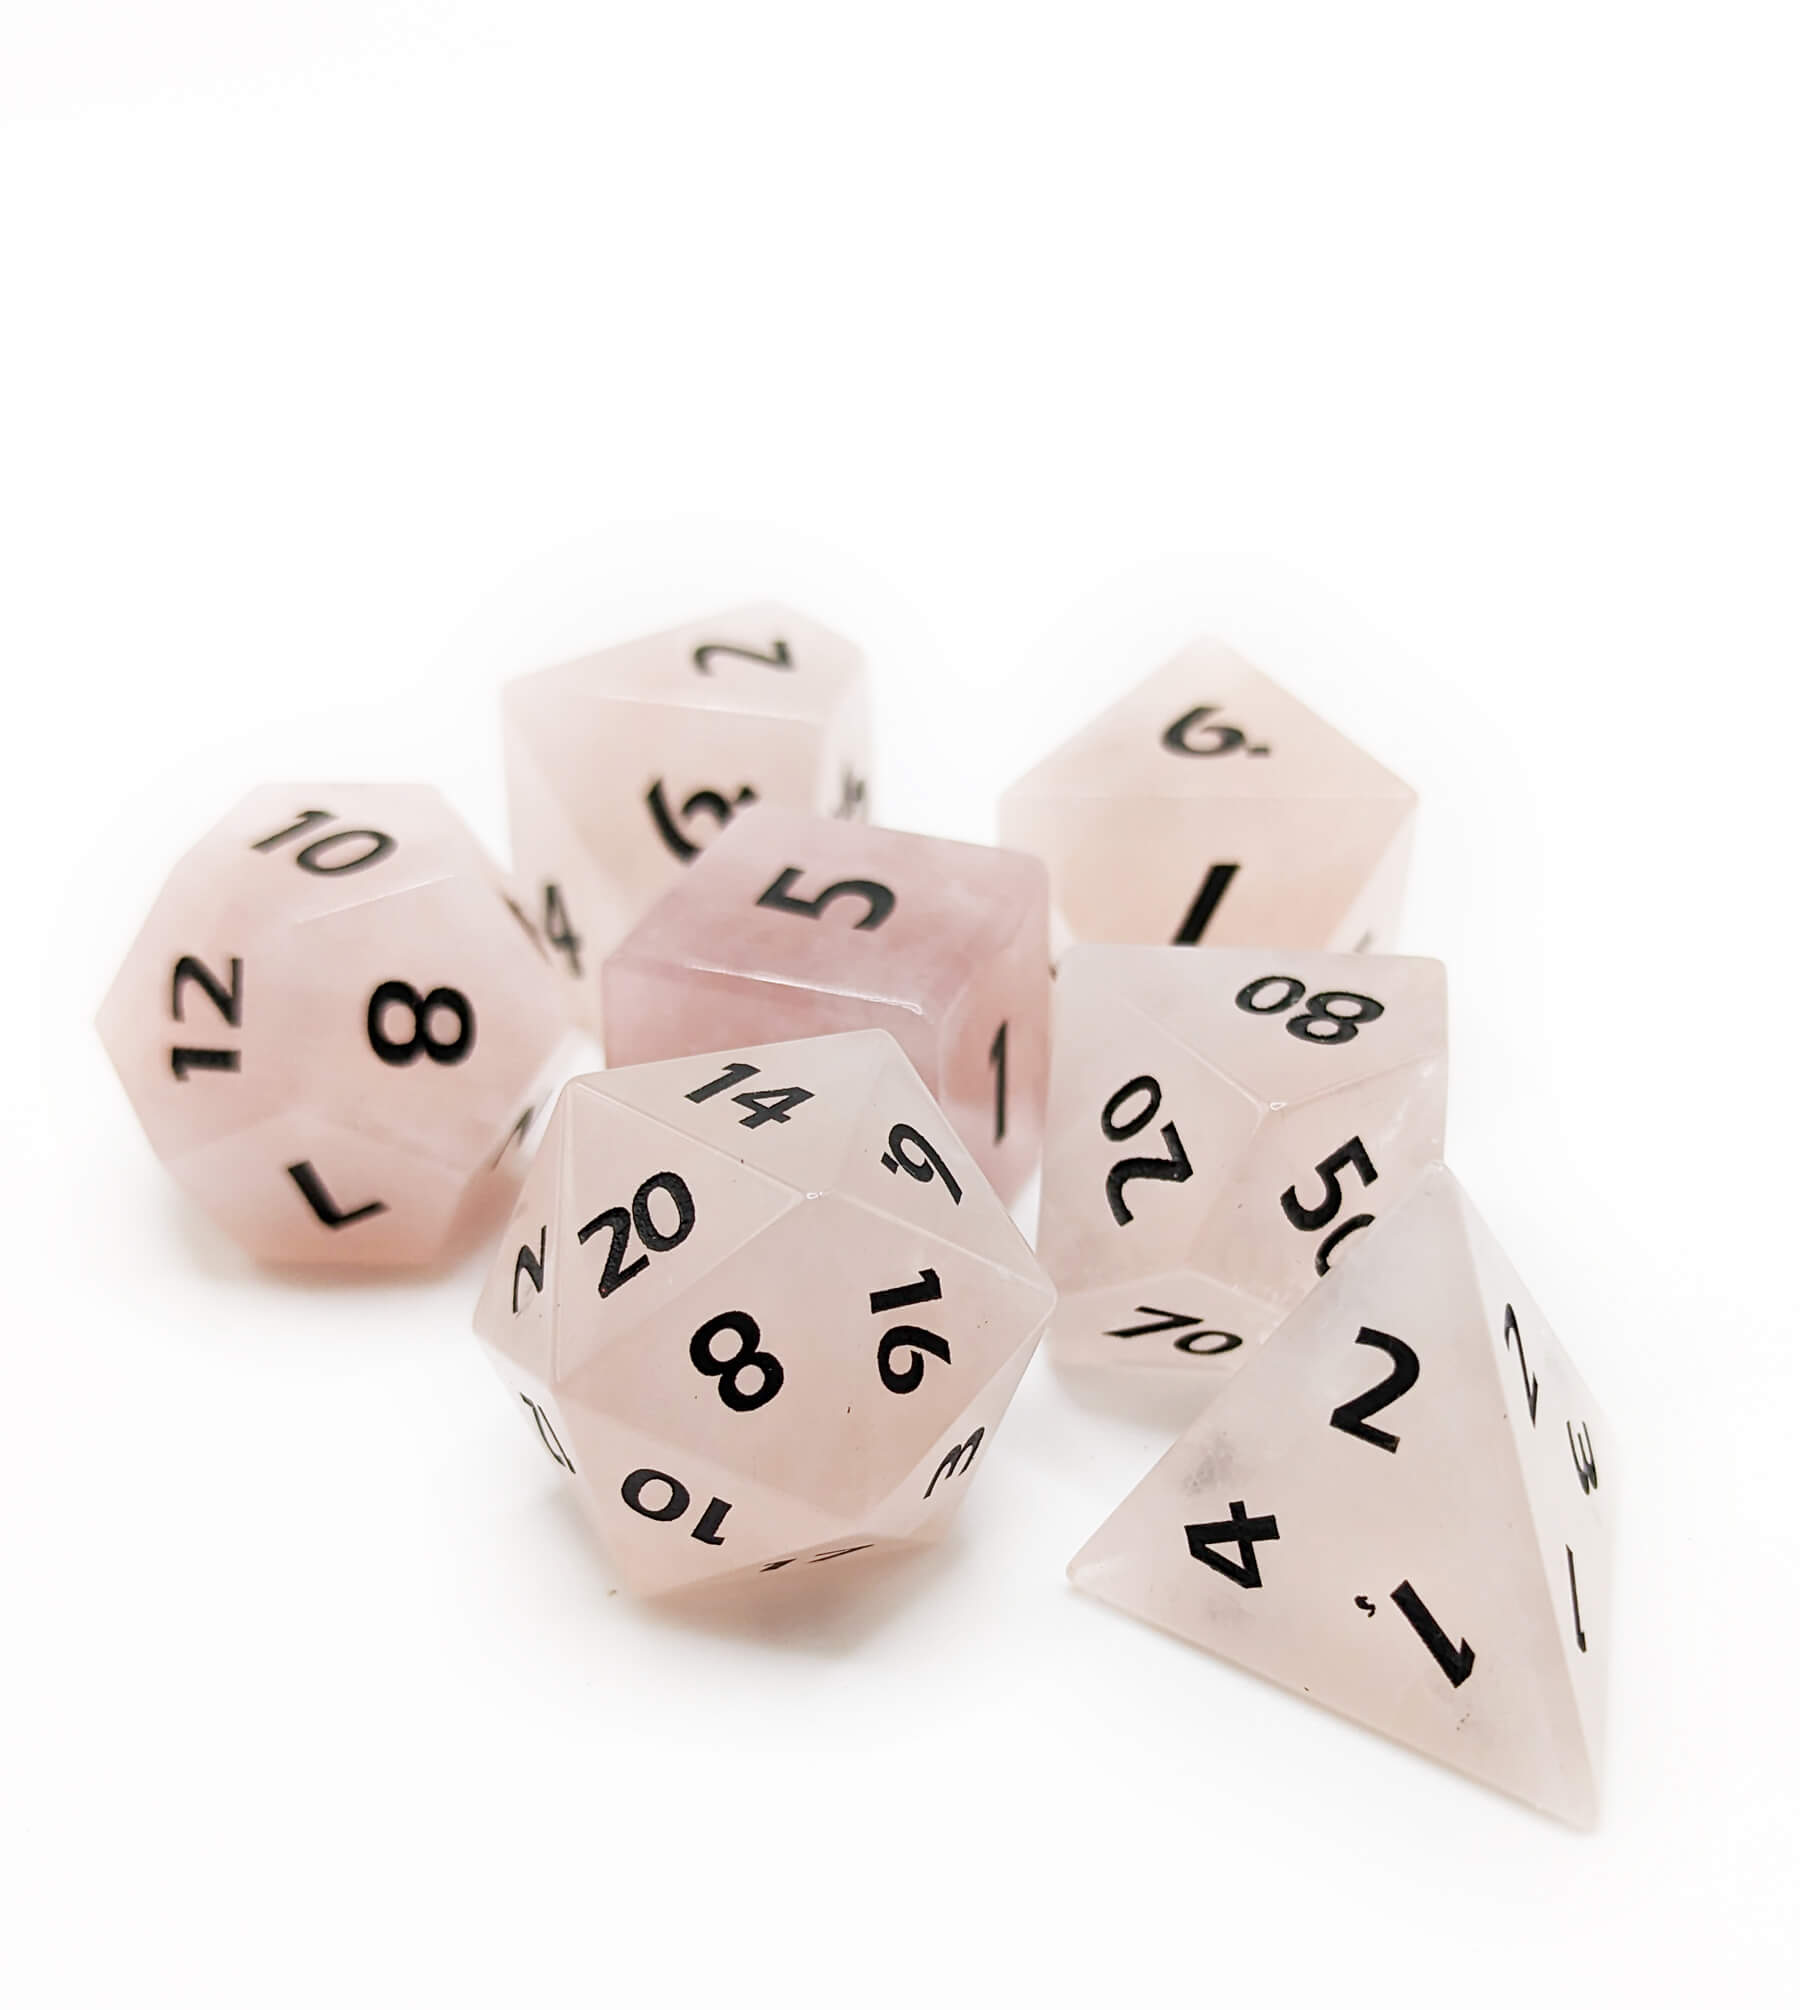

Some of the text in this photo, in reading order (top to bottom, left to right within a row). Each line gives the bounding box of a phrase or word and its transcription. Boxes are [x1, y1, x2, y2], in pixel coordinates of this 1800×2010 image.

[253, 811, 393, 875] 10
[755, 867, 896, 931] 5
[170, 956, 242, 1081] 12
[366, 980, 476, 1067] 8
[684, 1063, 815, 1129] 14
[989, 1020, 1008, 1144] 1
[1101, 1075, 1193, 1226] 20
[577, 1172, 695, 1299] 20
[689, 1311, 784, 1412] 8
[869, 1268, 951, 1394] 16
[1104, 1306, 1243, 1355] 70
[1505, 1304, 1538, 1426] 2
[1330, 1327, 1420, 1453] 2
[621, 1469, 732, 1545] 10
[924, 1427, 984, 1499] 3
[1184, 1501, 1280, 1589] 4
[1390, 1580, 1475, 1688] 1
